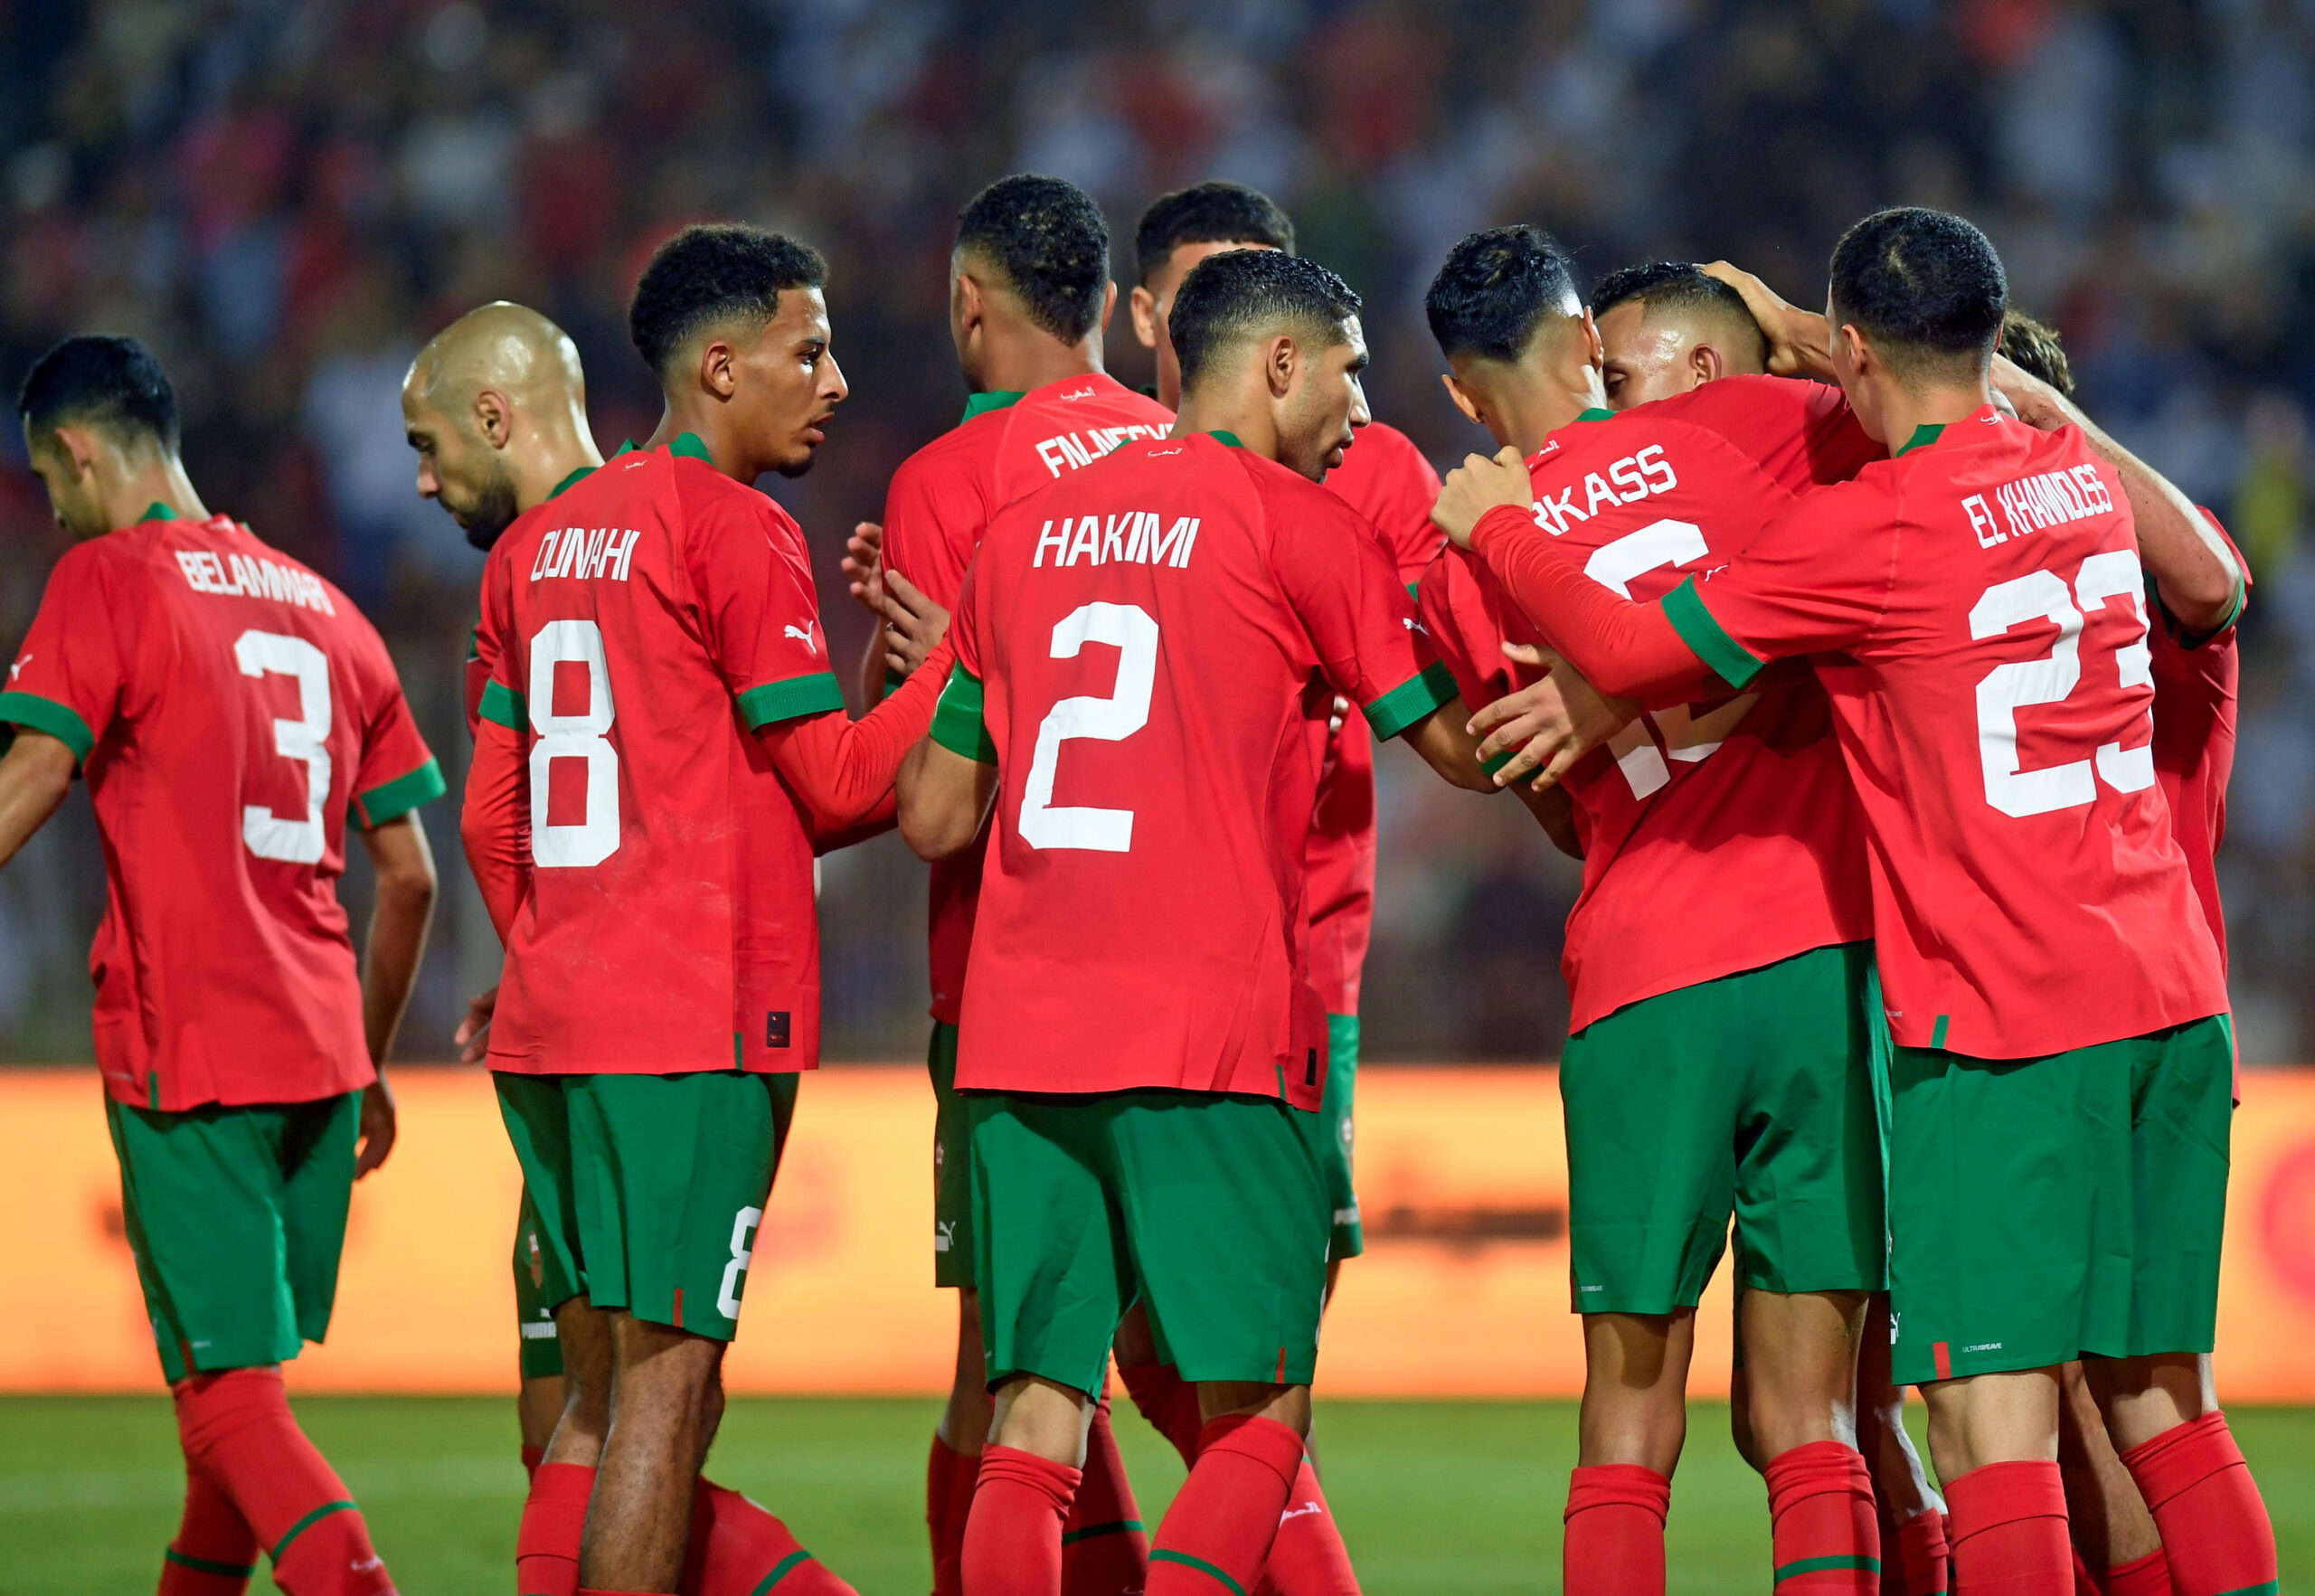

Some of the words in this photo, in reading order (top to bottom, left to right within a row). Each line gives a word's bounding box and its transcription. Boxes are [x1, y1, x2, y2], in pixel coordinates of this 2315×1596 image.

[530, 527, 641, 581] OUNAHI
[1033, 511, 1201, 569] HAKIMI
[1961, 494, 2008, 550] EL
[233, 629, 332, 864] 3
[528, 619, 620, 868] 8
[1018, 600, 1159, 853] 2
[1968, 549, 2156, 818] 23
[716, 1205, 763, 1320] 8
